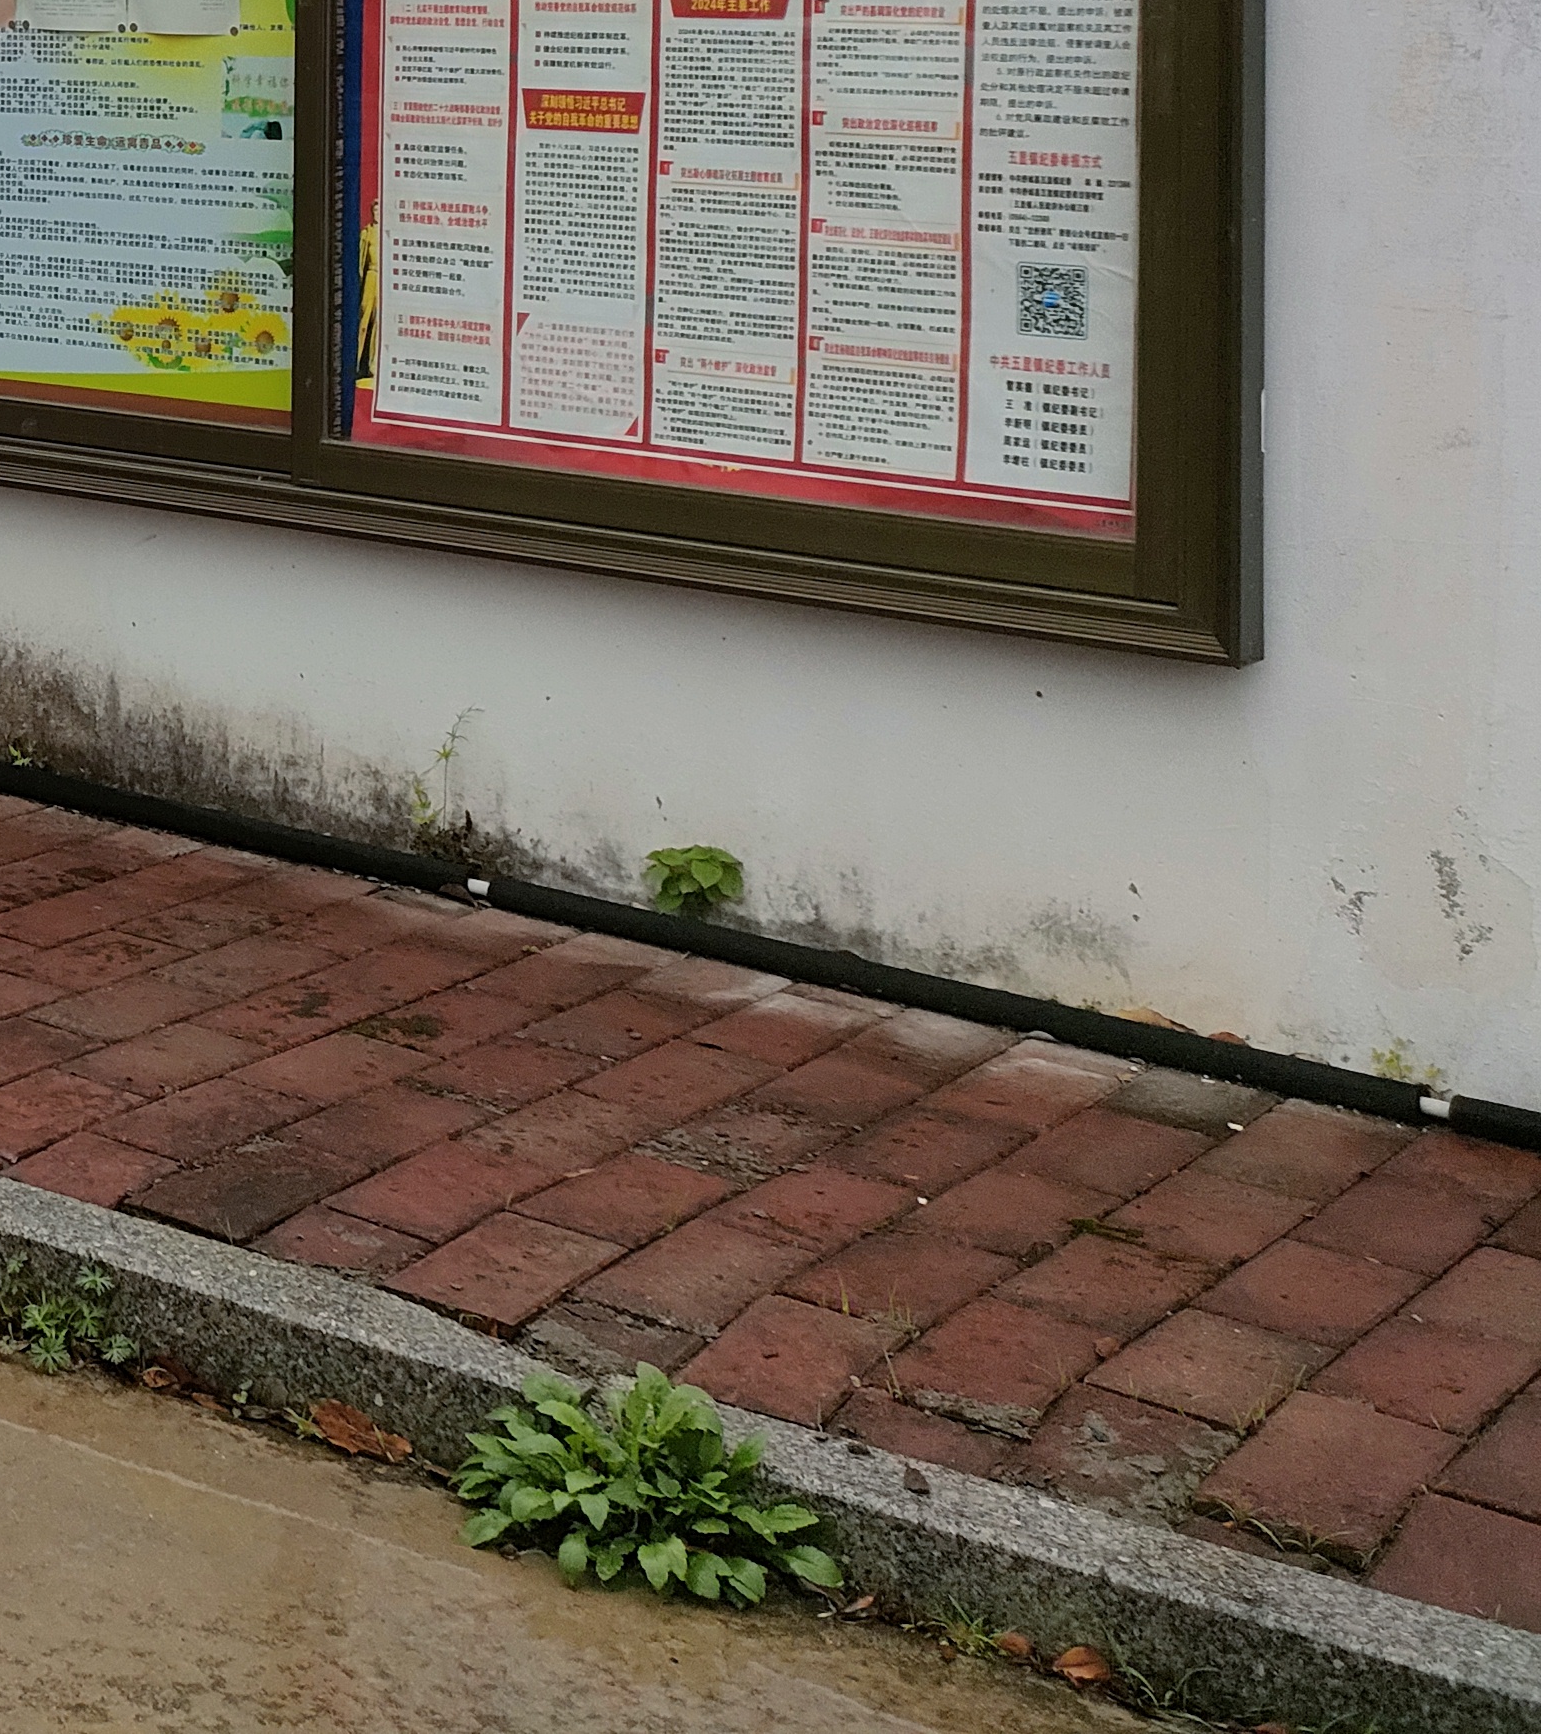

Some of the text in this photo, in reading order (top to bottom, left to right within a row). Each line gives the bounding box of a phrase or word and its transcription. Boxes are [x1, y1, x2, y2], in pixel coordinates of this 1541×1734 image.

[63, 134, 162, 150] 珍爱生命 远离毒品
[990, 355, 1111, 379] 中共五显镇纪委工作人员
